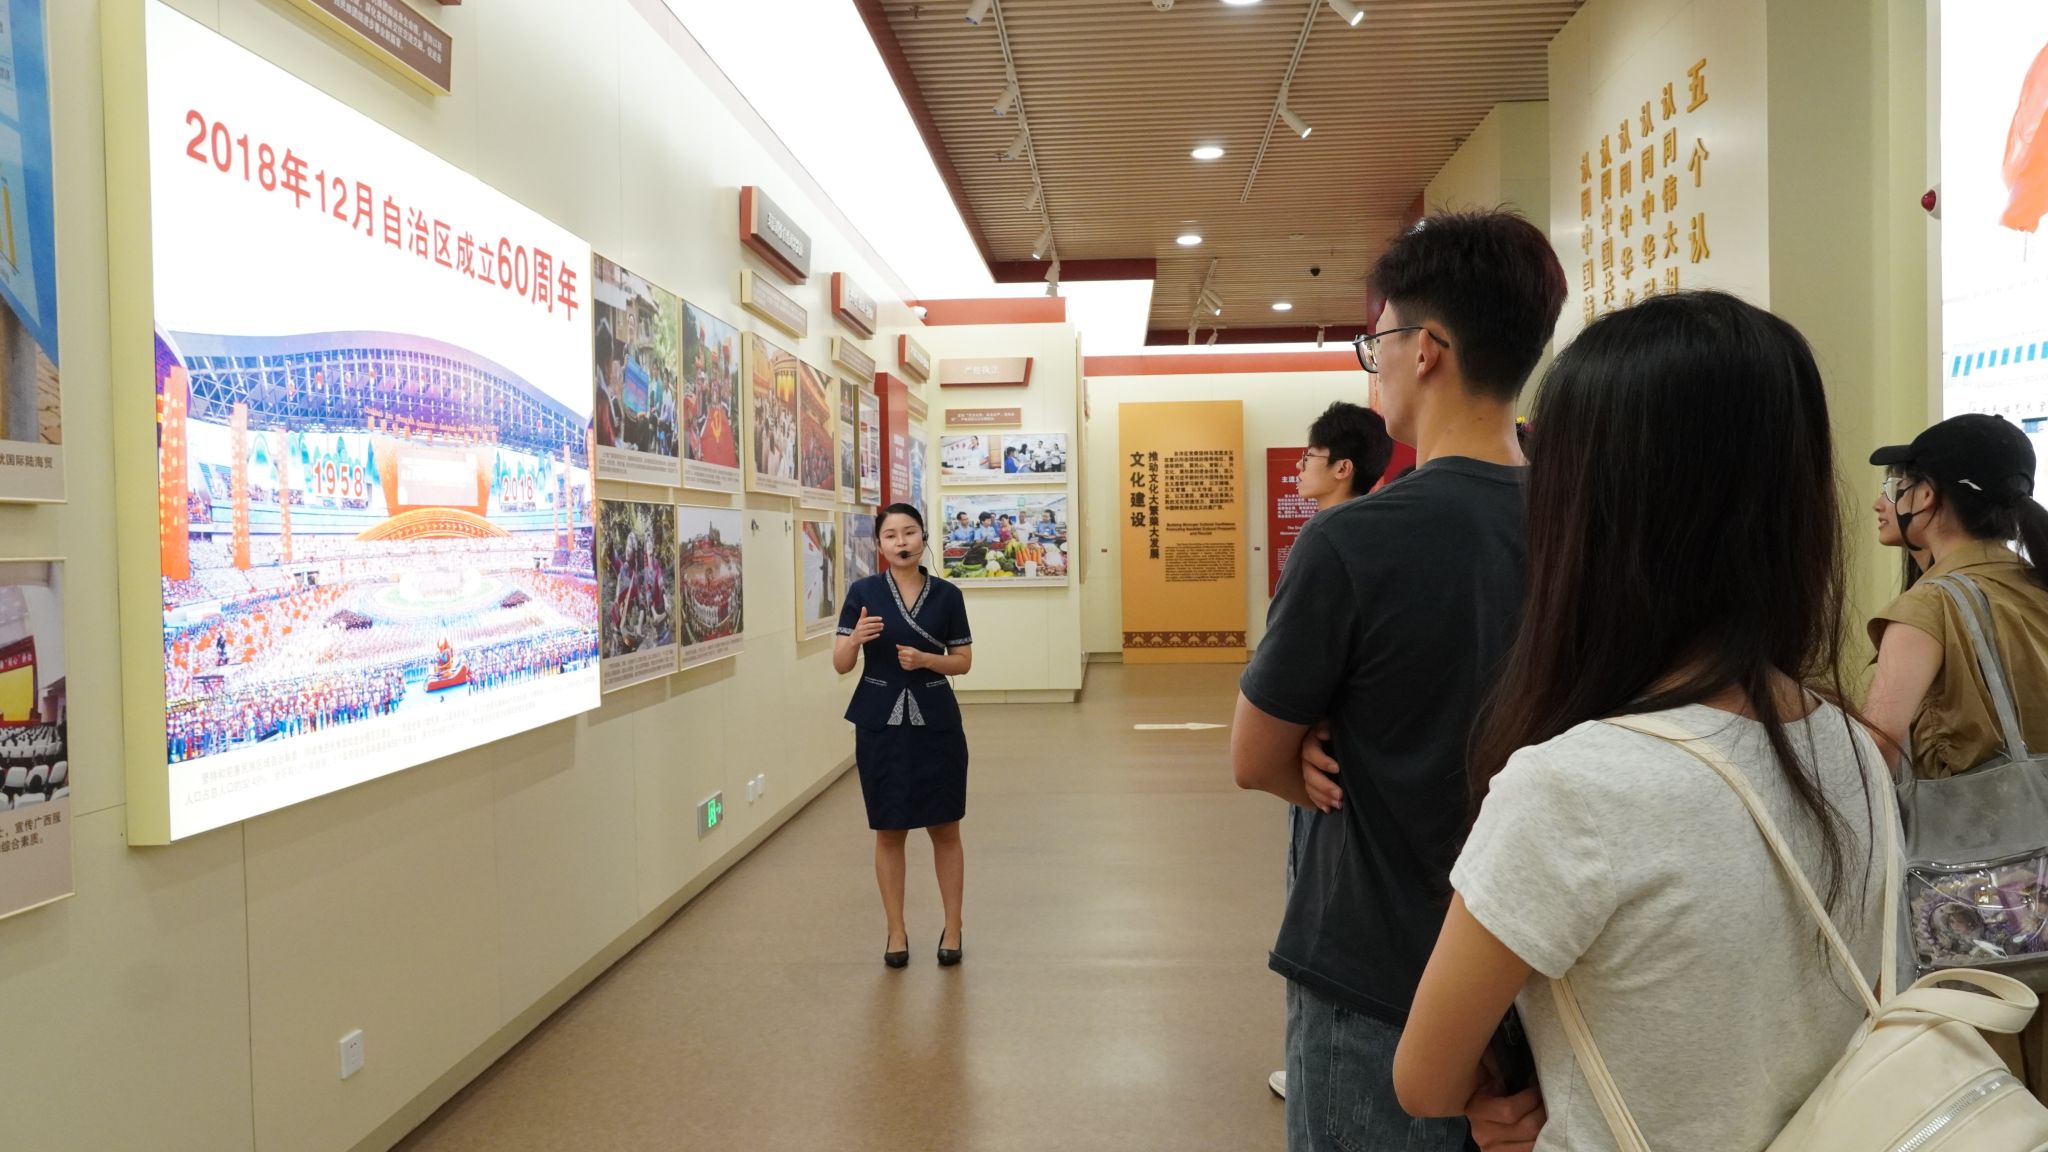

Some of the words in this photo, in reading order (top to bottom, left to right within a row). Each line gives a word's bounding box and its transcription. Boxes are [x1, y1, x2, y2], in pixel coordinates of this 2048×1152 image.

[1686, 57, 1711, 265] 五个认
[185, 109, 580, 321] 2018年12月自治区成立60周年
[313, 460, 365, 497] 1958
[503, 474, 534, 503] 2018
[1130, 451, 1146, 528] 文化建设
[1148, 451, 1160, 559] 推动文化大繁荣大发展
